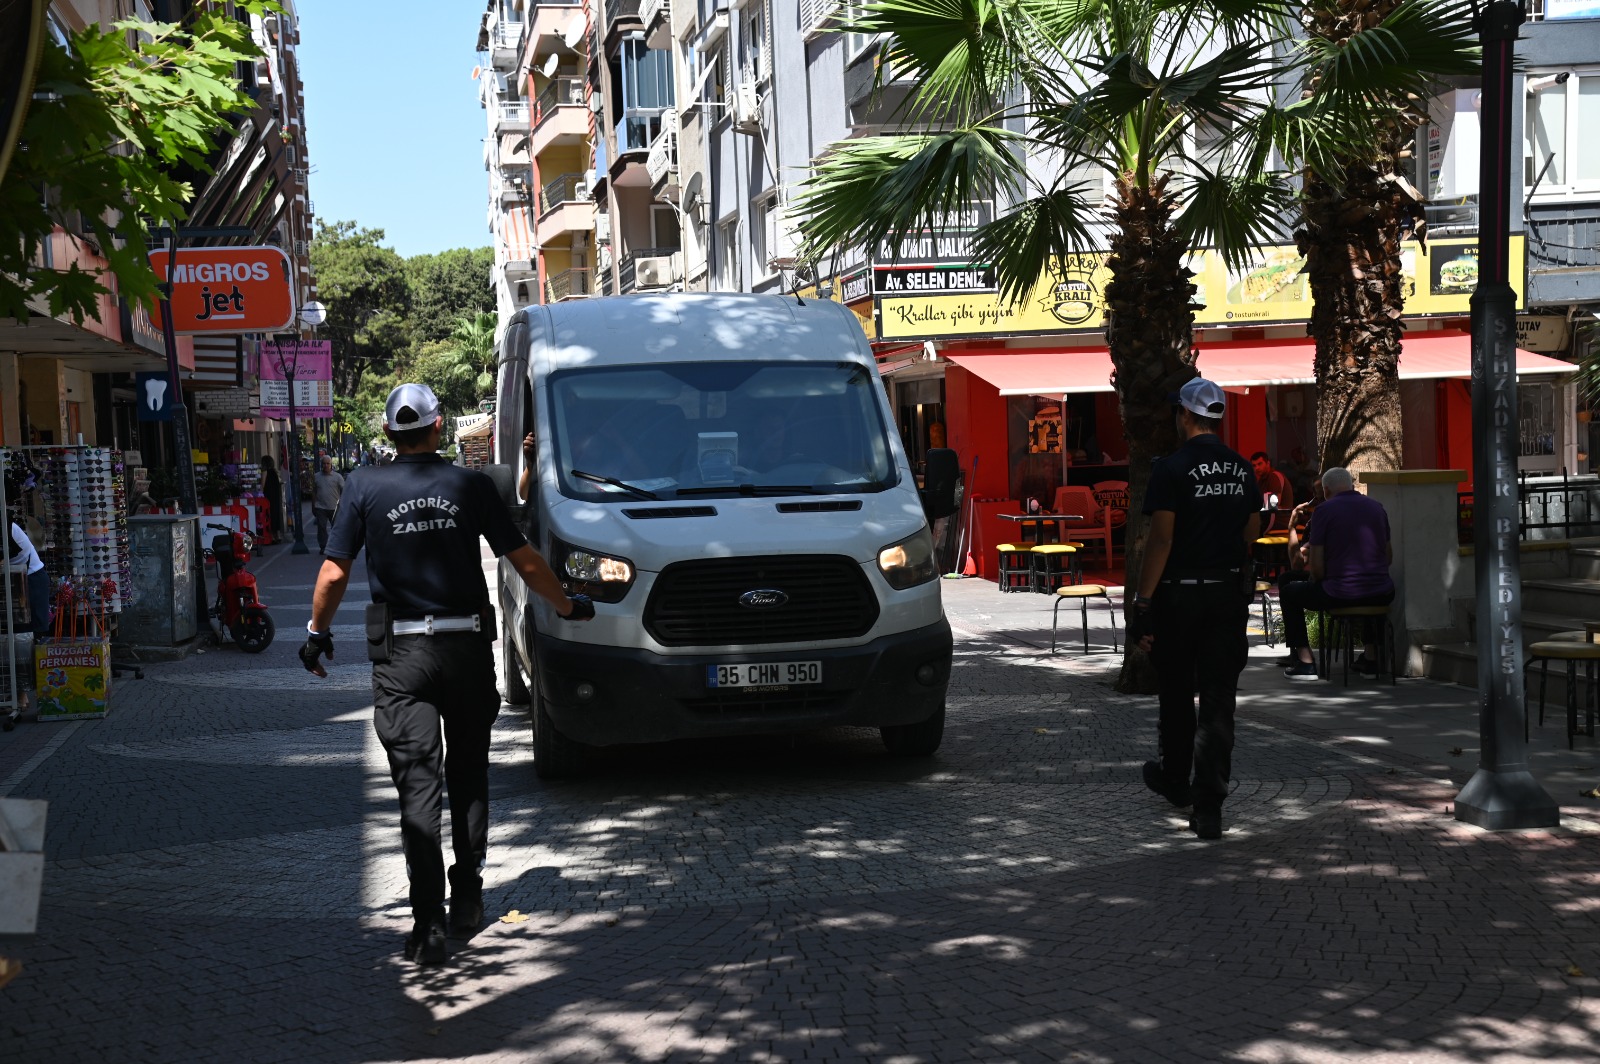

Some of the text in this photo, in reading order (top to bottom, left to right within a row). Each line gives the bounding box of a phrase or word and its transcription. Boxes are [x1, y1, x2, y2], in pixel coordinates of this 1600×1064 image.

[885, 273, 903, 290] Av.
[906, 271, 946, 290] SELEN
[949, 268, 986, 289] DENİZ
[1058, 283, 1087, 291] TOSTUN
[195, 284, 245, 320] jet
[1055, 291, 1091, 301] KRALI
[459, 417, 482, 427] BÜF
[1188, 461, 1248, 482] TRAFİK
[1097, 491, 1125, 500] TOSTUN
[1194, 482, 1244, 498] ZABITA
[386, 495, 460, 522] MOTORİZE
[392, 518, 457, 535] ZABITA
[750, 592, 777, 605] Ford
[47, 645, 91, 657] RÜZGAR
[39, 654, 100, 669] PERVANESİ
[718, 666, 740, 685] 35
[748, 664, 780, 684] CHN
[787, 663, 818, 682] 950
